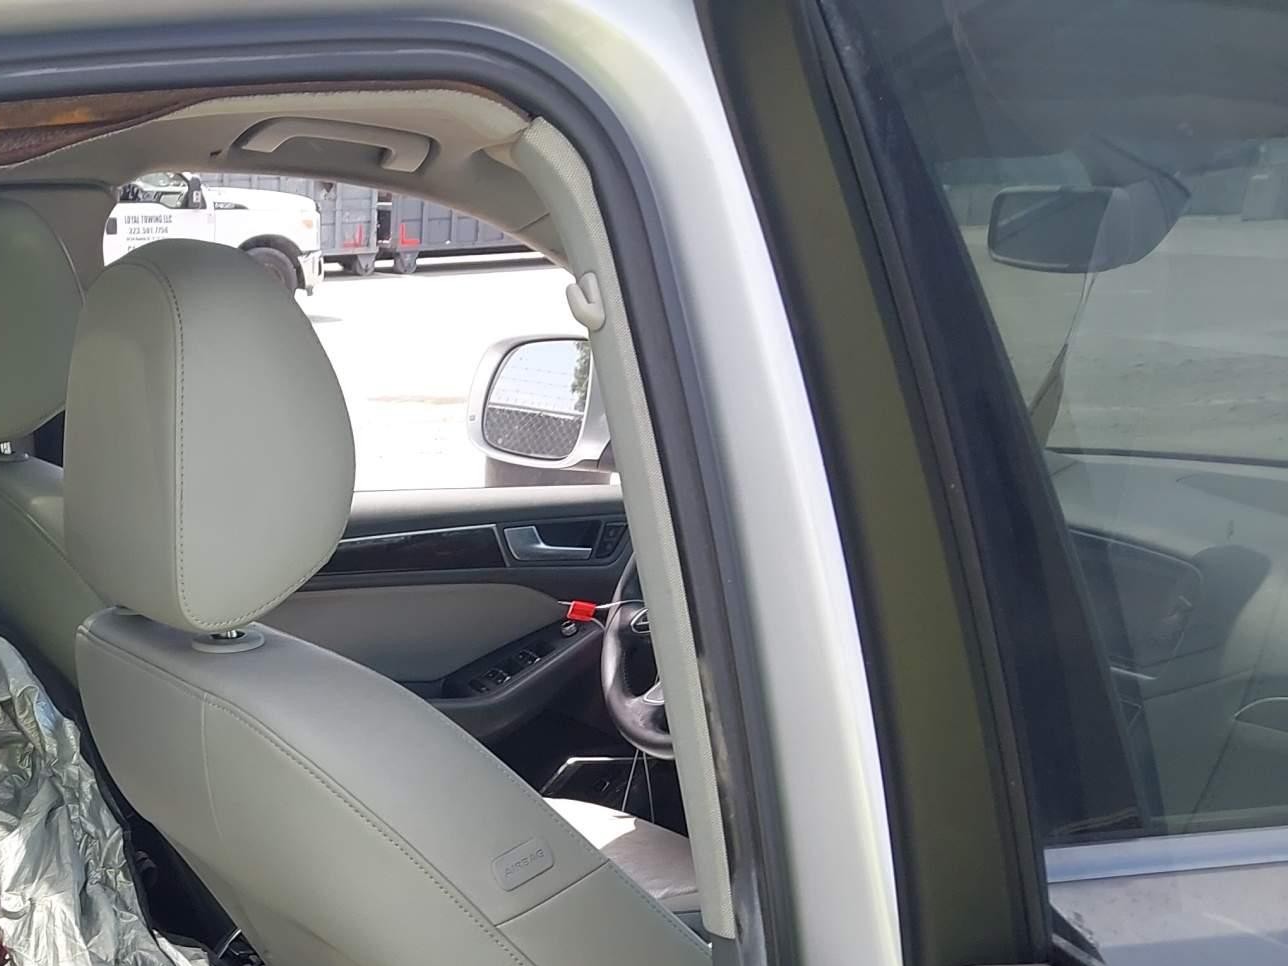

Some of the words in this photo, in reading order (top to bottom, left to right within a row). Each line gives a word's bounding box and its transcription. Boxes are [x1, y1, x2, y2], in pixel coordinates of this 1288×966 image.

[124, 215, 140, 224] LOYAL
[141, 214, 163, 224] TOWING
[164, 214, 173, 223] LLC
[504, 848, 545, 878] AIRBAG
